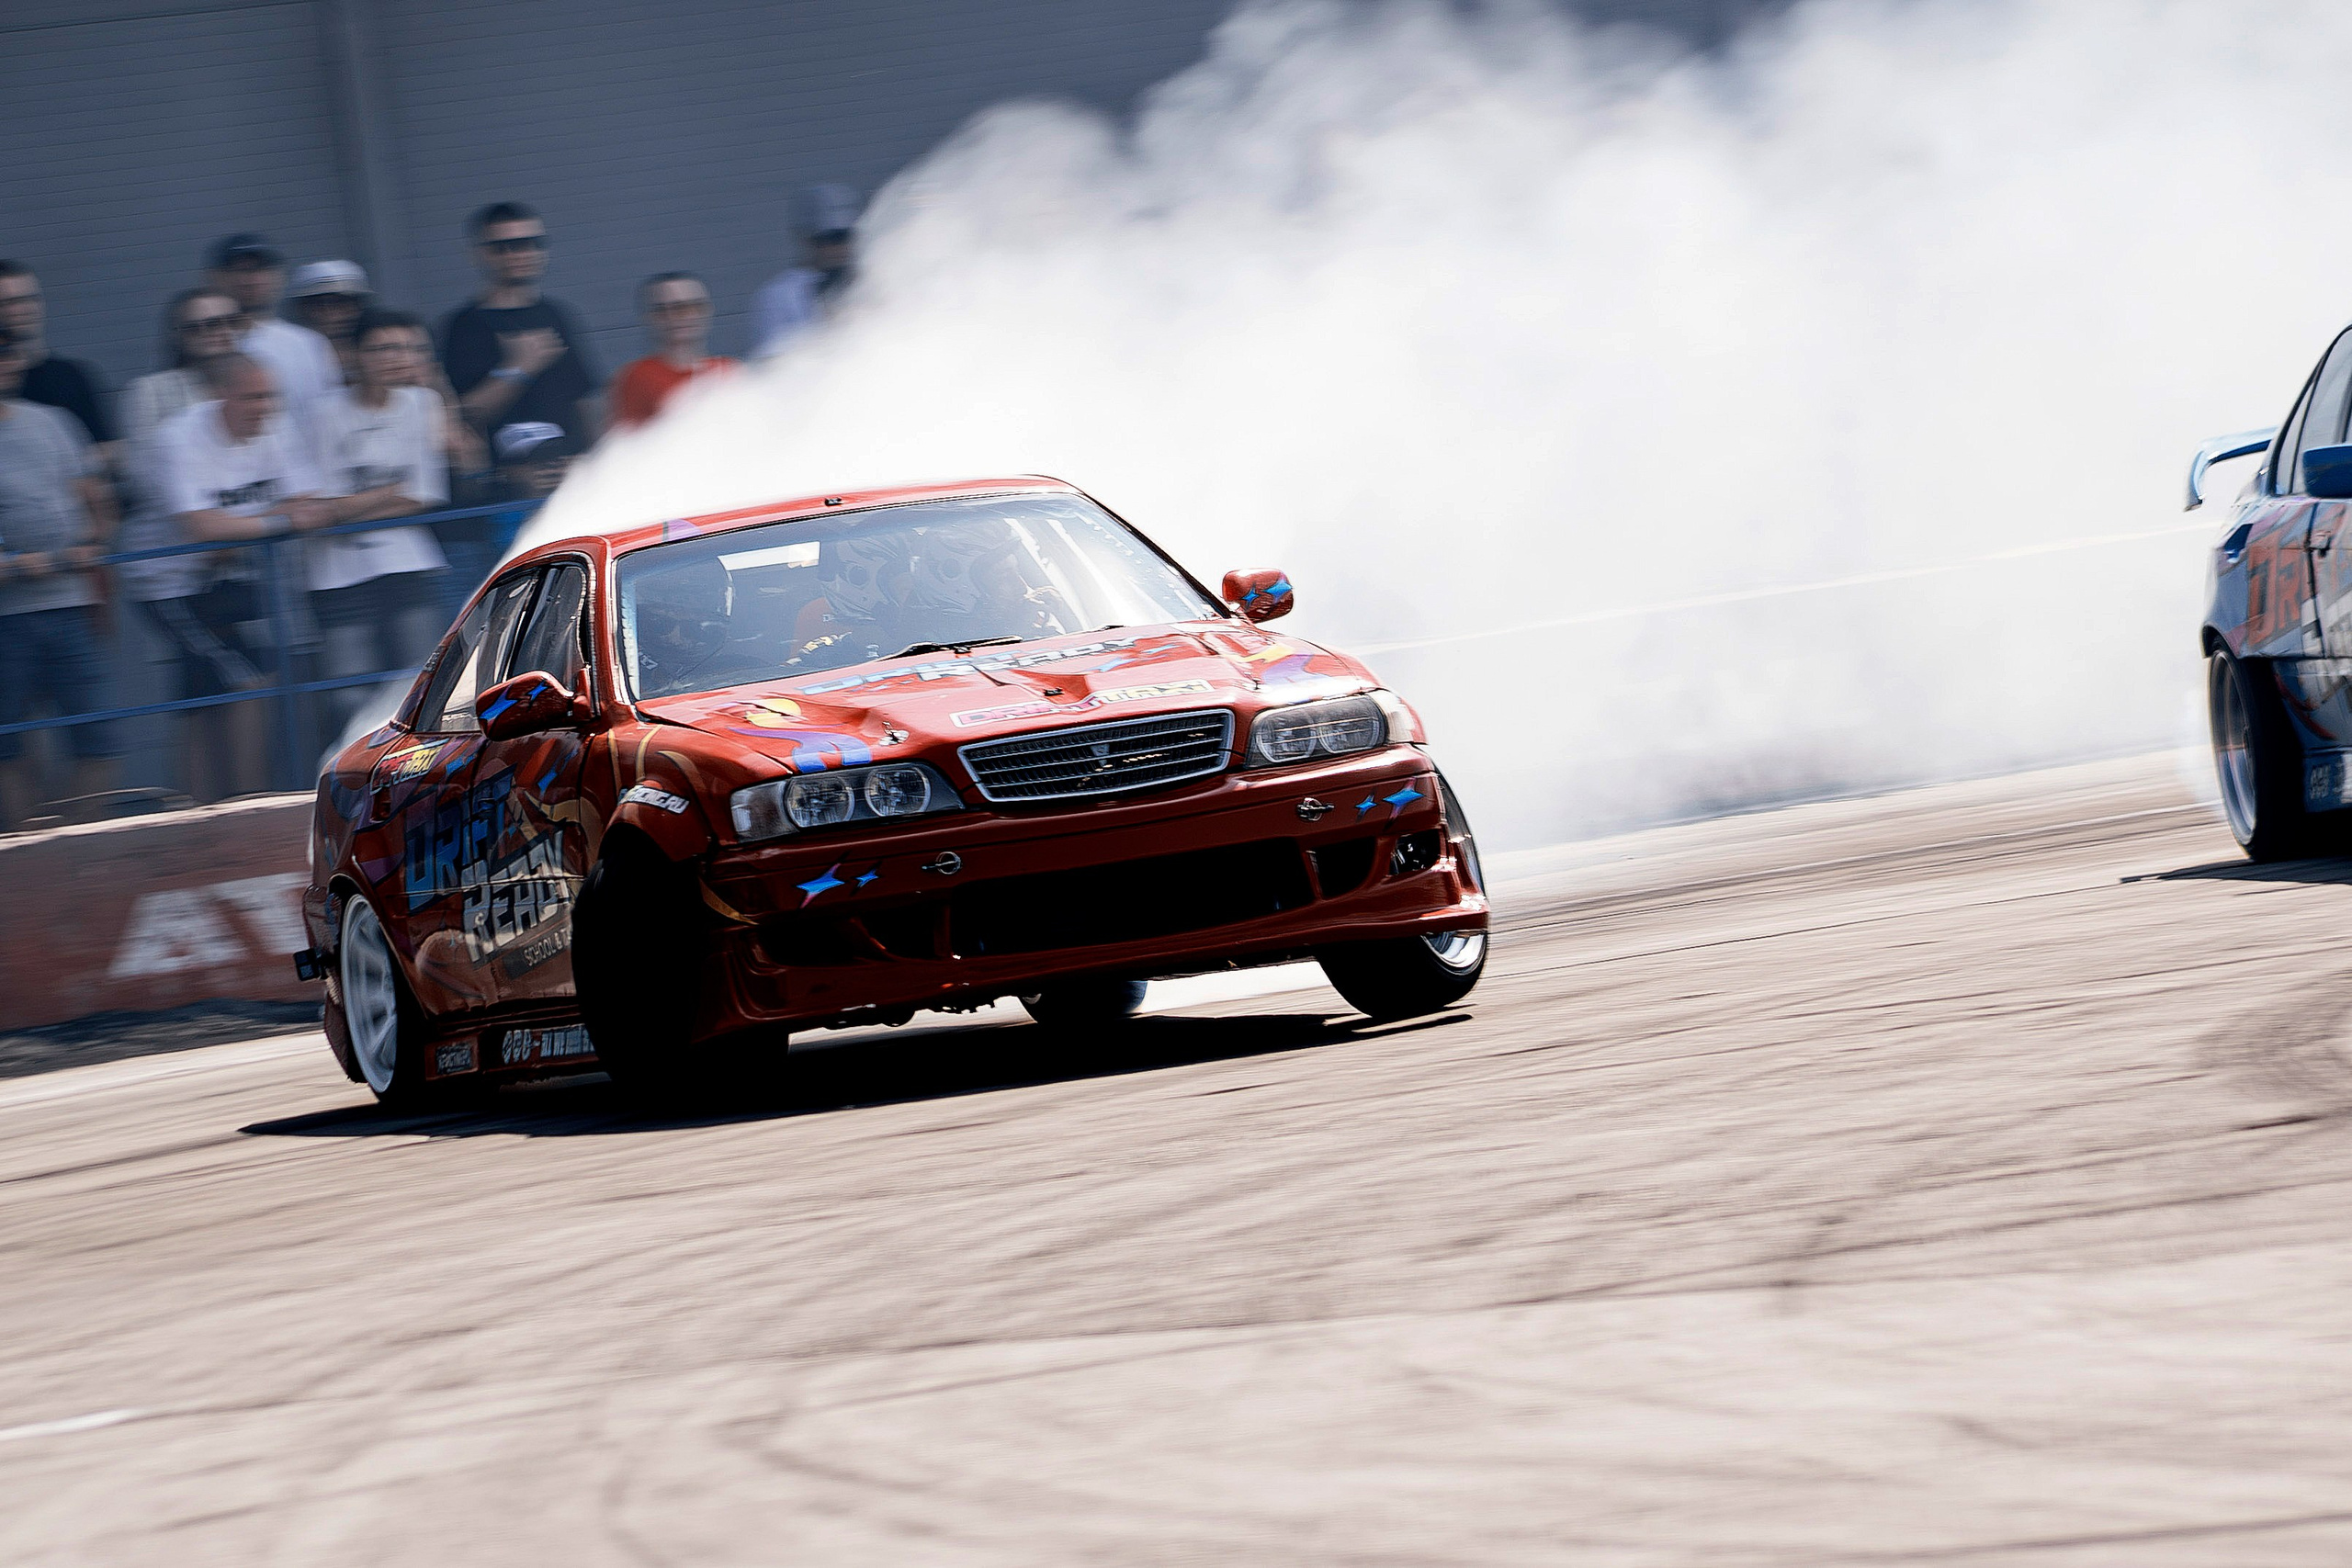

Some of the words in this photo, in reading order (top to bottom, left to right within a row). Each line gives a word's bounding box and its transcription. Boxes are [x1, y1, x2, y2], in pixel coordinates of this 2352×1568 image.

[919, 635, 1146, 682] READY
[1102, 679, 1211, 704] TAXI
[405, 773, 515, 911] DRIFT
[461, 829, 570, 963] READY
[523, 937, 557, 966] SCHOOL
